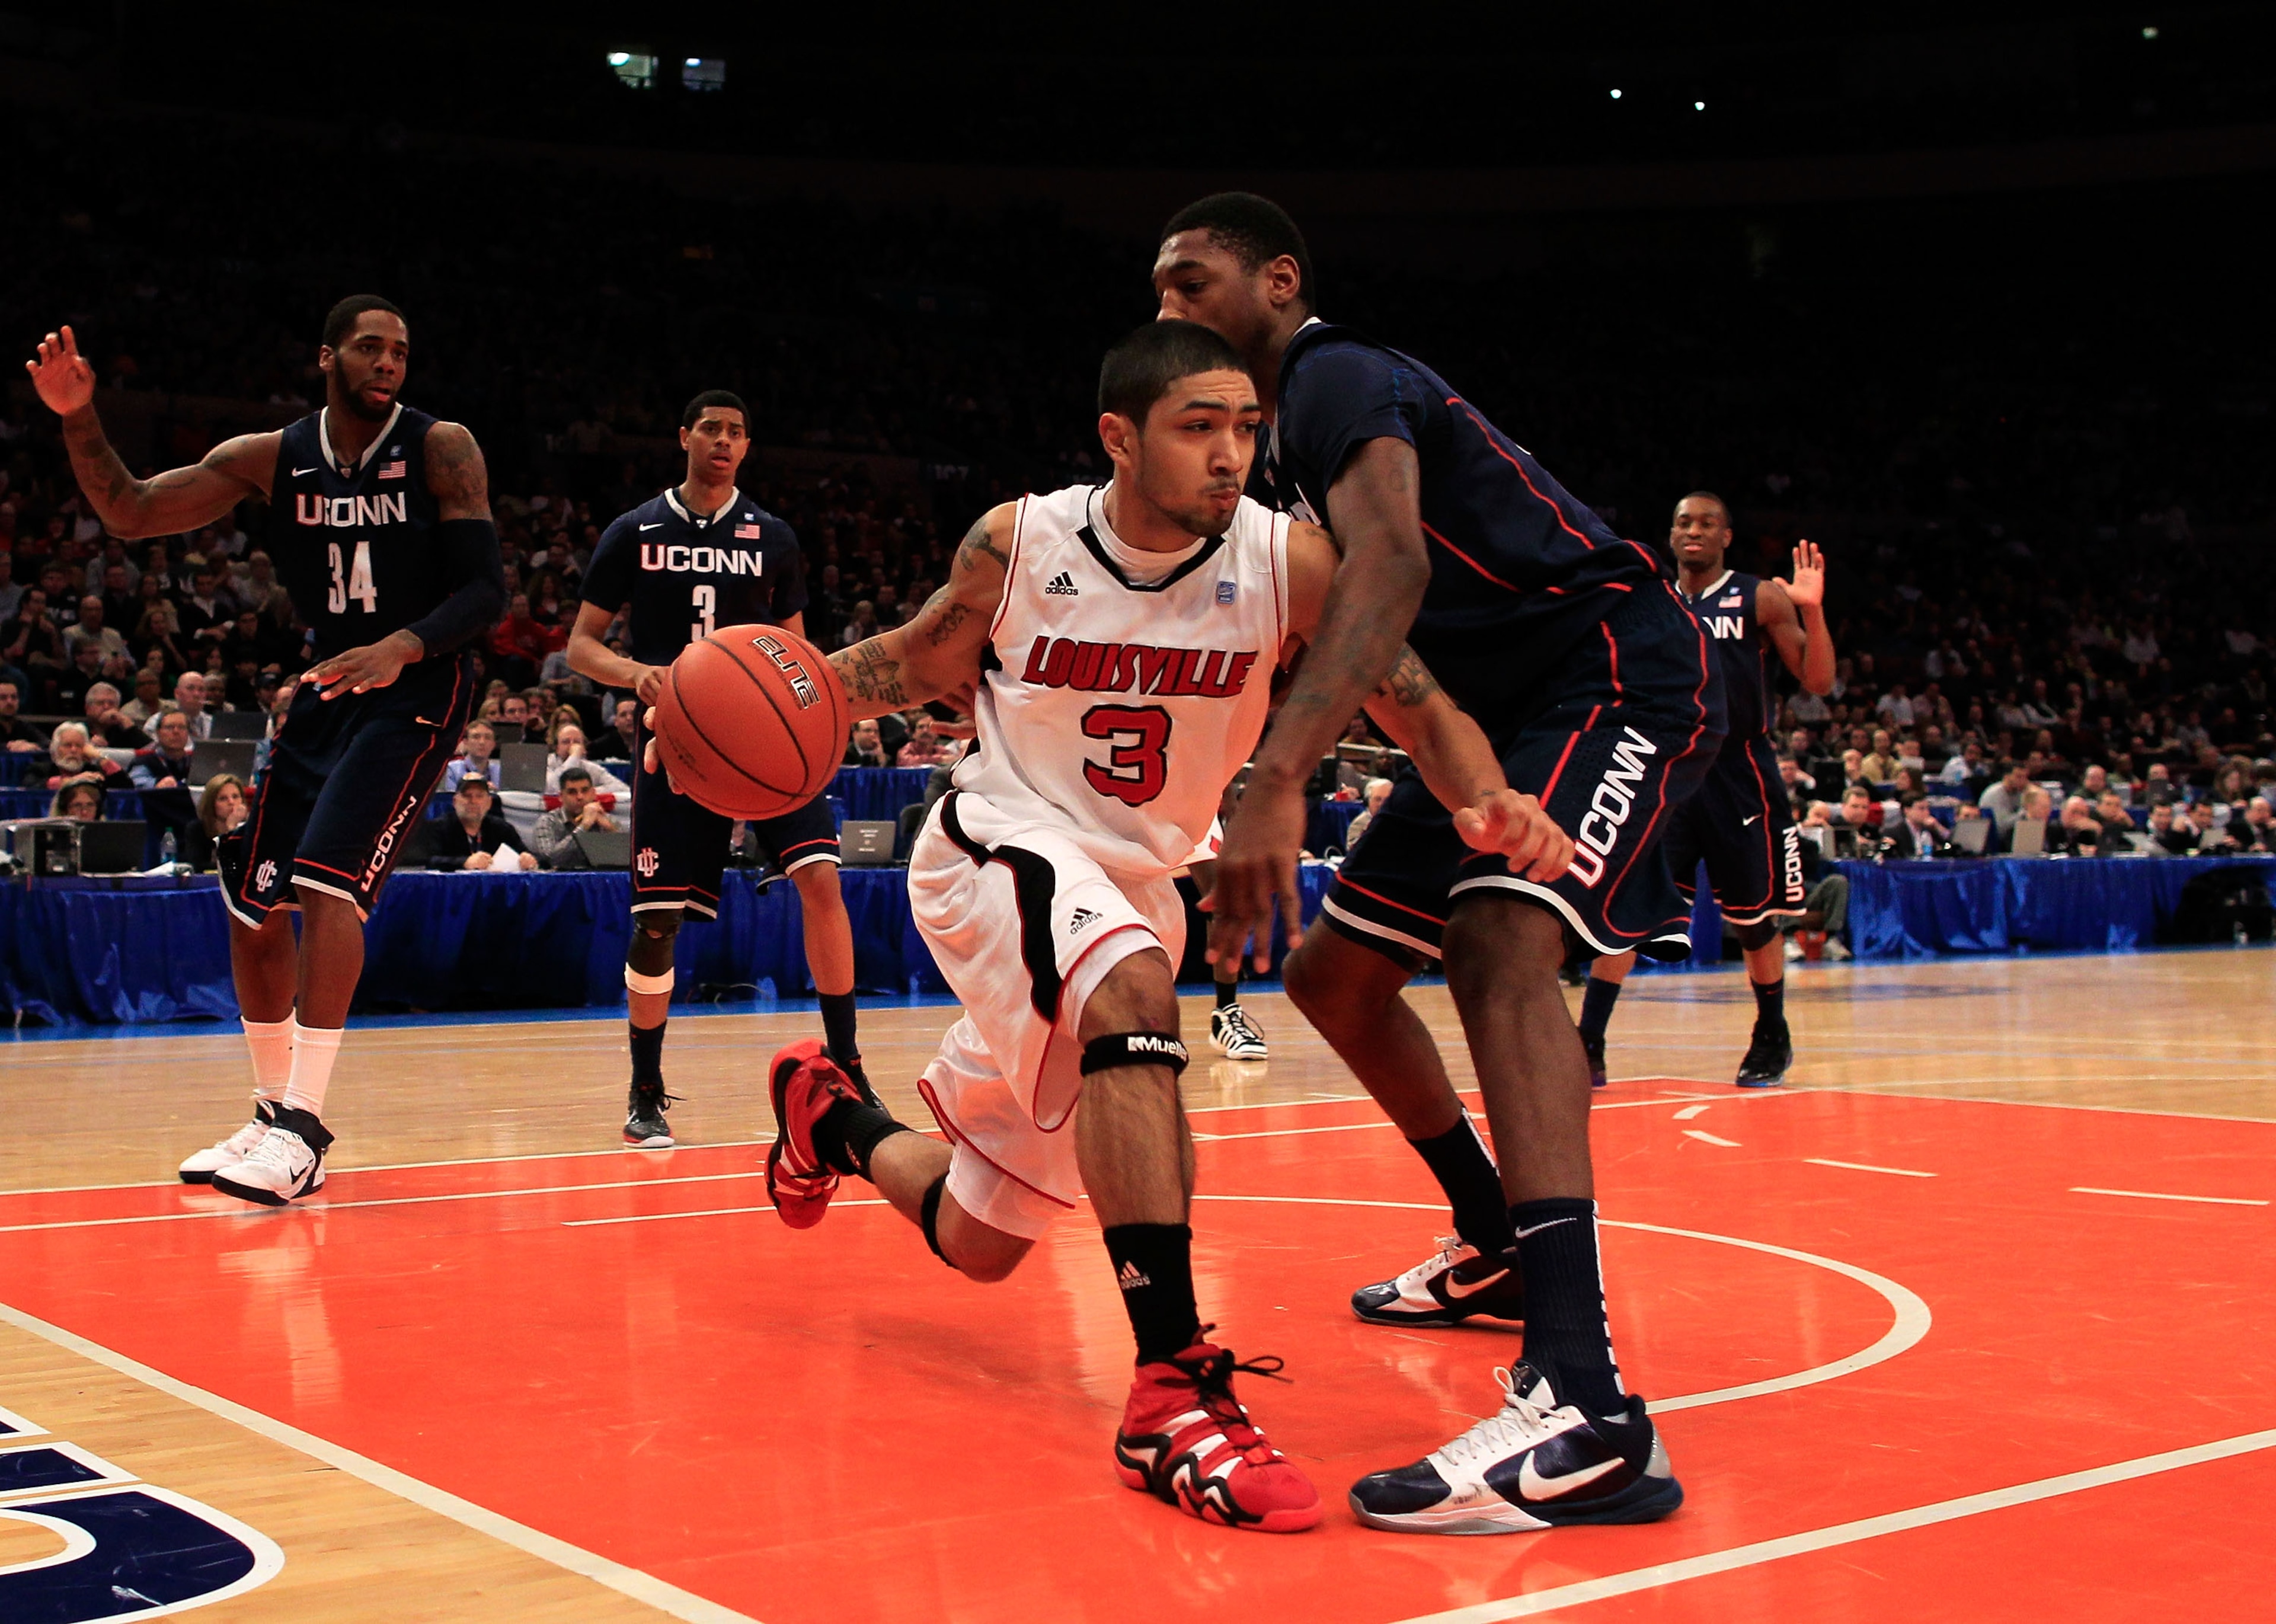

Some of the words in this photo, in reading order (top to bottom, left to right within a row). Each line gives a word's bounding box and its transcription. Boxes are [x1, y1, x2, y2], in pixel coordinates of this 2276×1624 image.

[296, 491, 407, 528] UONN
[328, 541, 377, 614] 34
[640, 544, 762, 576] UCONN
[691, 584, 716, 641] 3
[1045, 585, 1079, 596] adidas
[752, 635, 821, 709] ELITE
[1020, 635, 1258, 698] LOUISVILLE
[1081, 704, 1172, 807] 3
[1567, 725, 1658, 888] UCONN
[1782, 826, 1805, 902] UCONN
[1070, 913, 1104, 935] adidas
[1136, 1036, 1187, 1062] Muelle
